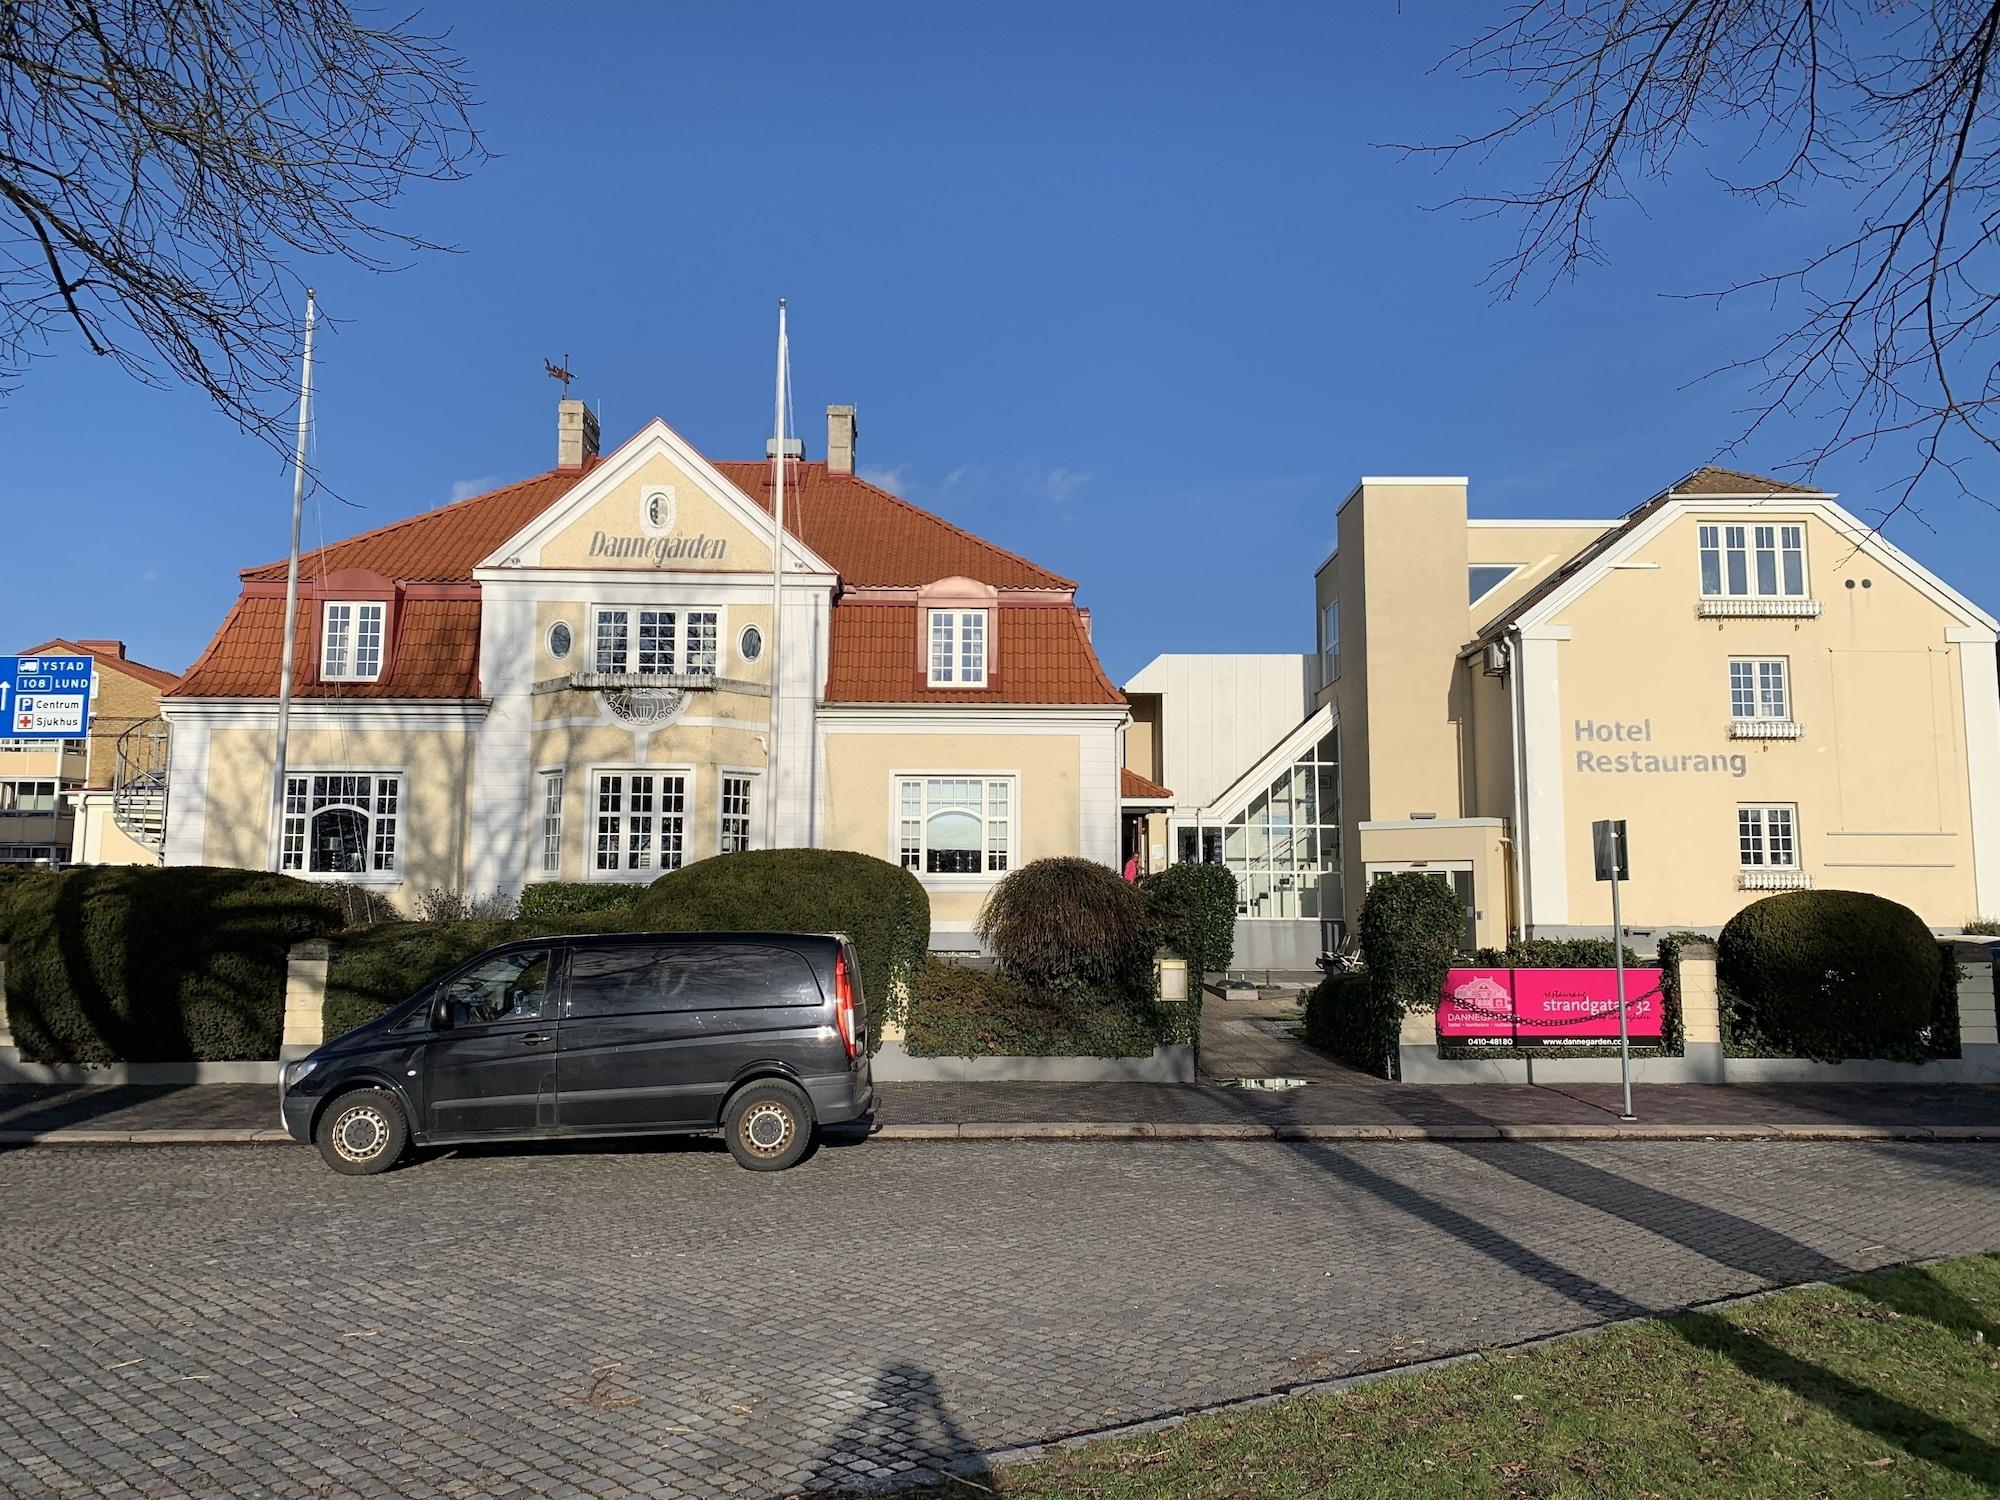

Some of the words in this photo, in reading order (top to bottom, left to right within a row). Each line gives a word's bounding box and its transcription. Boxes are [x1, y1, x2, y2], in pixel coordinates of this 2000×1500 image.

[588, 531, 727, 567] Dannegården
[42, 661, 84, 671] YSTAD
[22, 679, 46, 689] 108
[54, 679, 89, 689] LUND
[36, 700, 79, 709] Centrum
[36, 717, 78, 727] Sjukhus
[1574, 719, 1651, 742] Hotel
[1576, 750, 1747, 778] Restaurang
[1543, 996, 1631, 1015] strandgata
[1636, 1001, 1651, 1015] 32
[1543, 1038, 1630, 1046] www.dannegarden.co
